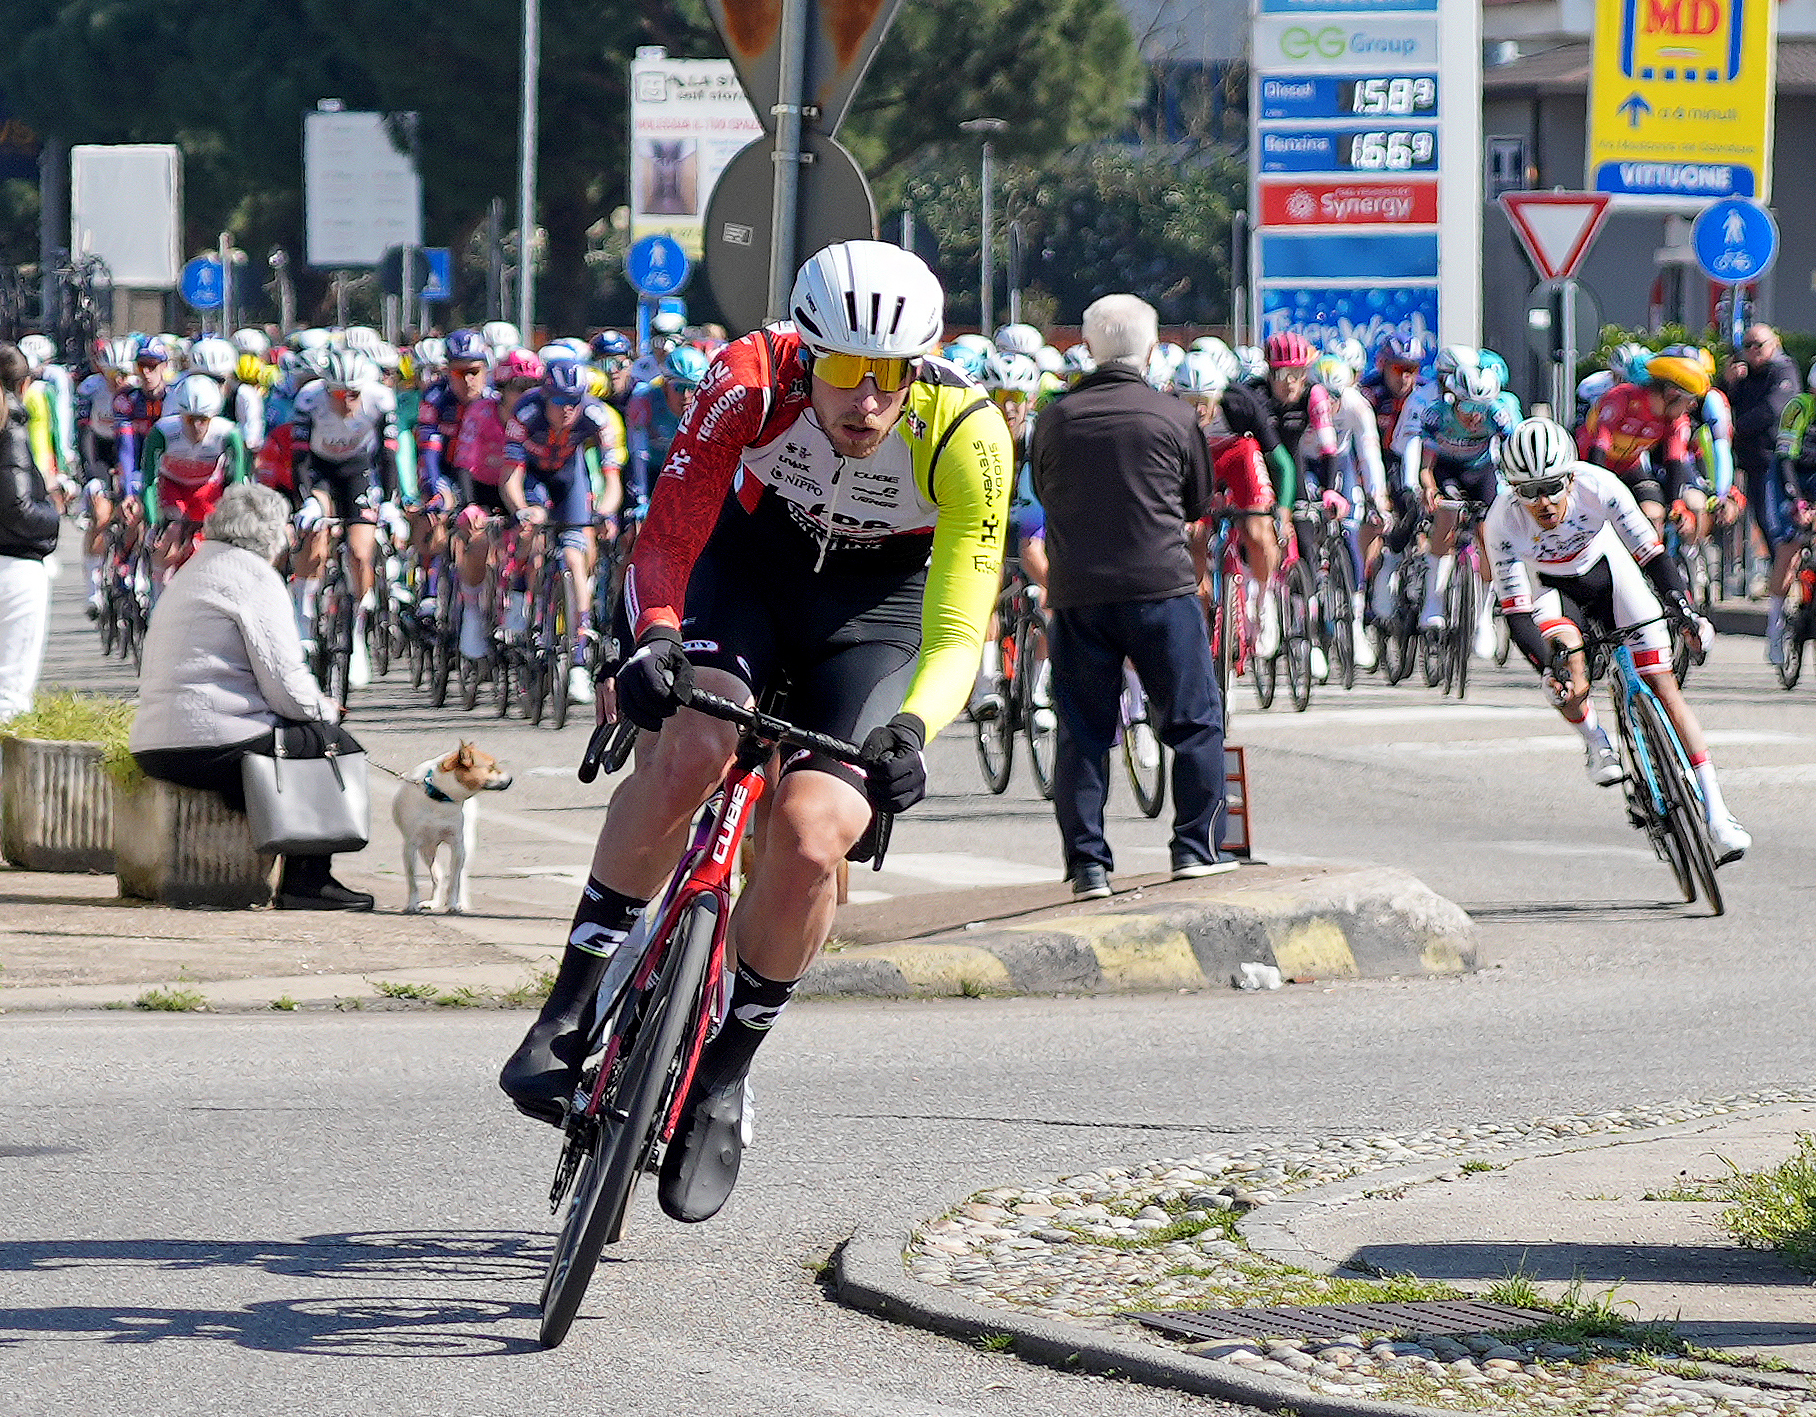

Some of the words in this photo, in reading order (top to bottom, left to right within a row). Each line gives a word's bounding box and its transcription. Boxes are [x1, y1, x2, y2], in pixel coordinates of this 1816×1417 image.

[1645, 0, 1721, 35] MD
[1351, 32, 1416, 55] Group
[1619, 162, 1734, 191] VITTUONE
[1320, 191, 1414, 220] Synergy
[696, 384, 747, 442] TECHNORD
[784, 473, 823, 497] NIPPO
[712, 783, 749, 865] CUBE
